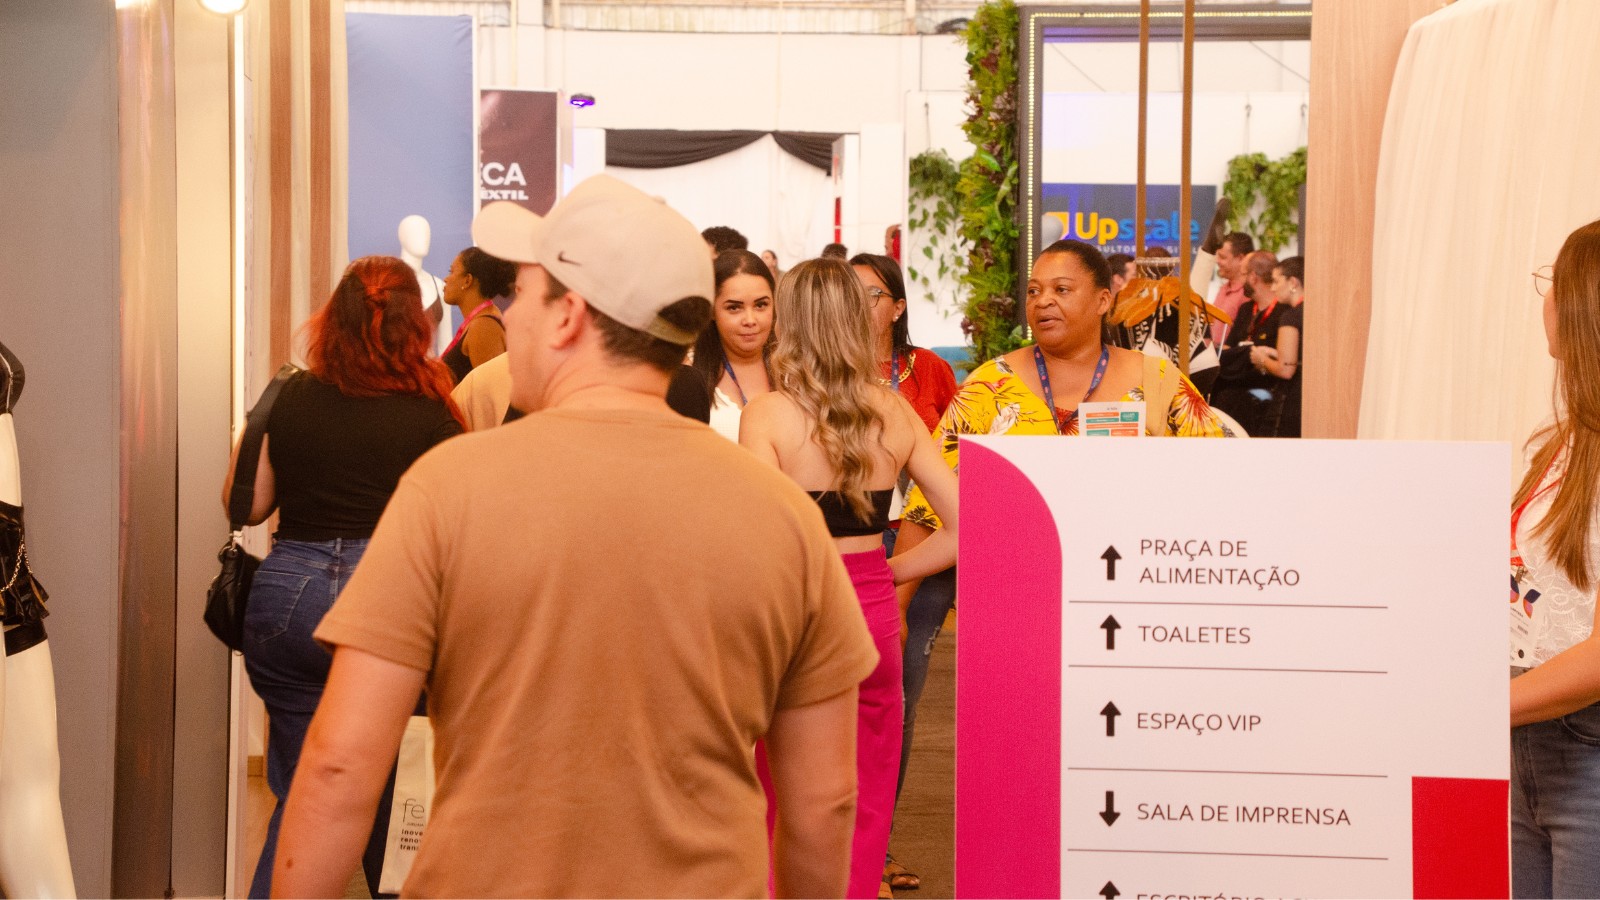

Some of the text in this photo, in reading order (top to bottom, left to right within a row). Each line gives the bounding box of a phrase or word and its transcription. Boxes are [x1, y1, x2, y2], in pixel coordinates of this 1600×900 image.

[480, 161, 527, 186] CA
[1075, 210, 1200, 245] Upsale
[1140, 538, 1248, 562] PRAÇA DE
[1139, 566, 1300, 591] ALIMENTAÇÃO
[1138, 625, 1251, 644] TOALETES
[1137, 712, 1262, 735] ESPAÇO VIP
[403, 798, 425, 823] fe
[1137, 803, 1352, 826] SALA DE IMPRENSA
